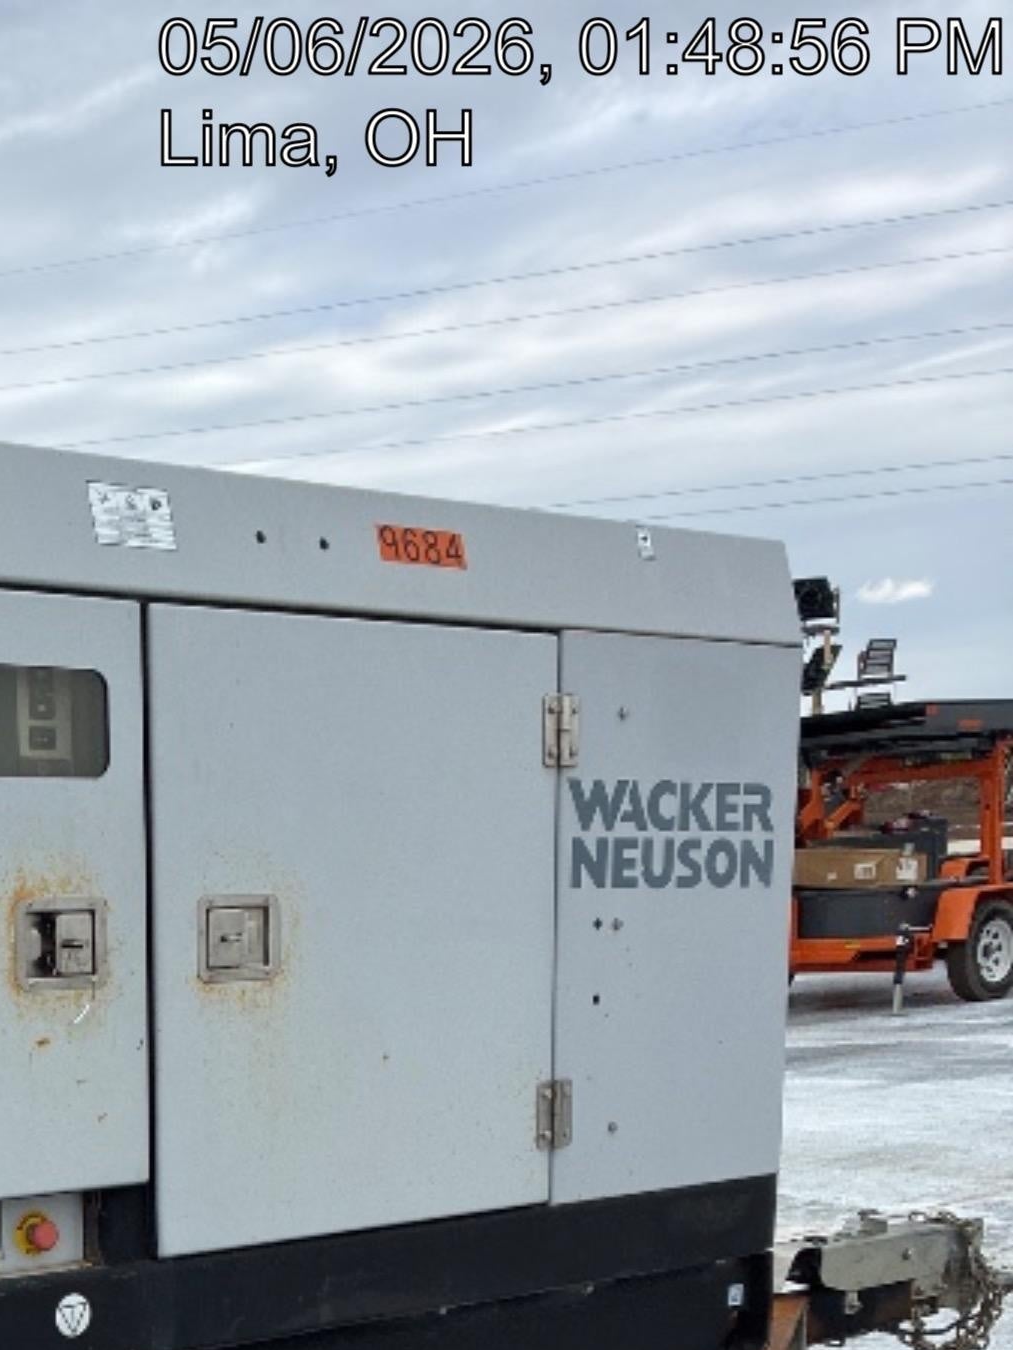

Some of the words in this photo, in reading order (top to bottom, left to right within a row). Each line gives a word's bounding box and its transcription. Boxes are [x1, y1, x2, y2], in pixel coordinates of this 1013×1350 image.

[379, 524, 463, 568] 9684
[567, 777, 774, 832] WACKER
[570, 836, 774, 889] NEUSON
